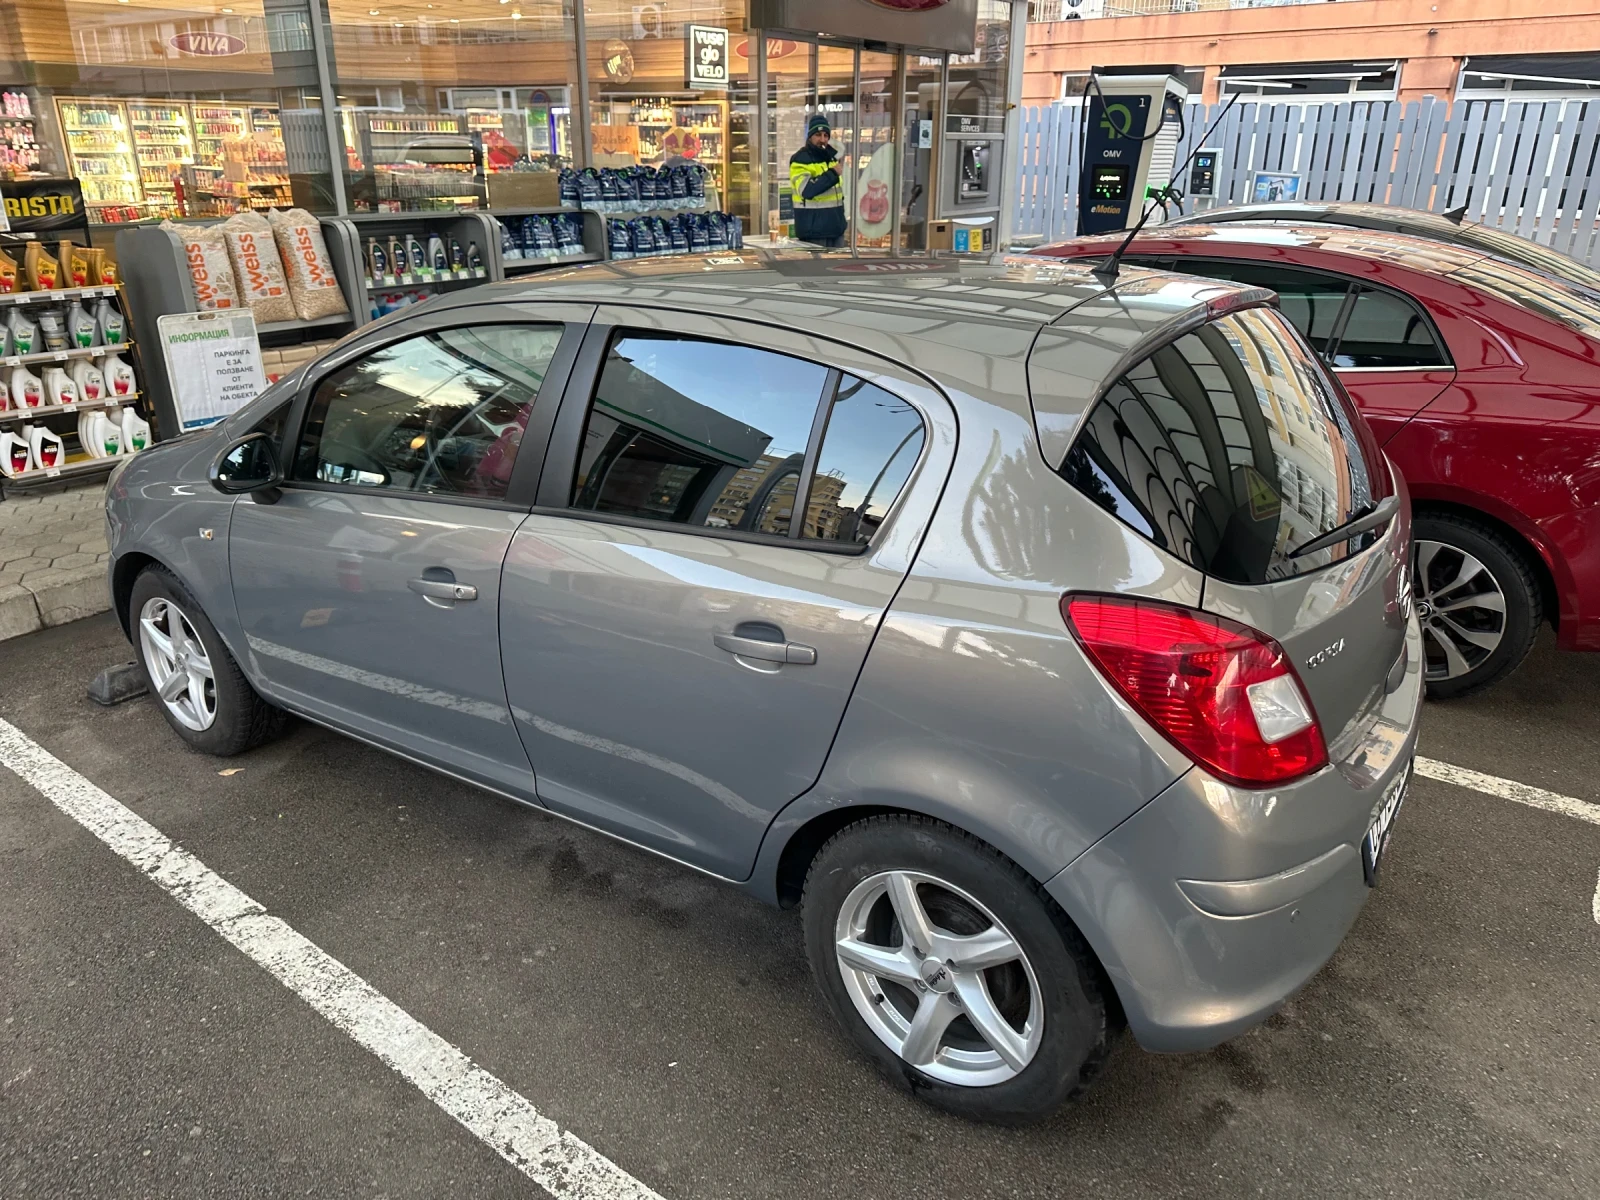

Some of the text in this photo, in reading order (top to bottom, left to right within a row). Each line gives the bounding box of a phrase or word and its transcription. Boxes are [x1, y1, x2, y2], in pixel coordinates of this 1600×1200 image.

[189, 35, 228, 51] VIVA
[700, 45, 720, 65] glo
[696, 64, 724, 77] VELO
[1139, 98, 1146, 107] 1
[1103, 150, 1122, 158] OMV
[1090, 204, 1121, 214] eMotion
[296, 227, 323, 283] weiss
[238, 233, 267, 291] weiss
[168, 329, 230, 344] ИНФОРМАЦИЯ
[214, 349, 251, 358] ПАРКИНГА
[216, 366, 254, 375] ПОЛЗВАНЕ
[222, 383, 254, 392] КЛИЕНТИ
[231, 391, 258, 400] ОБЕКТА
